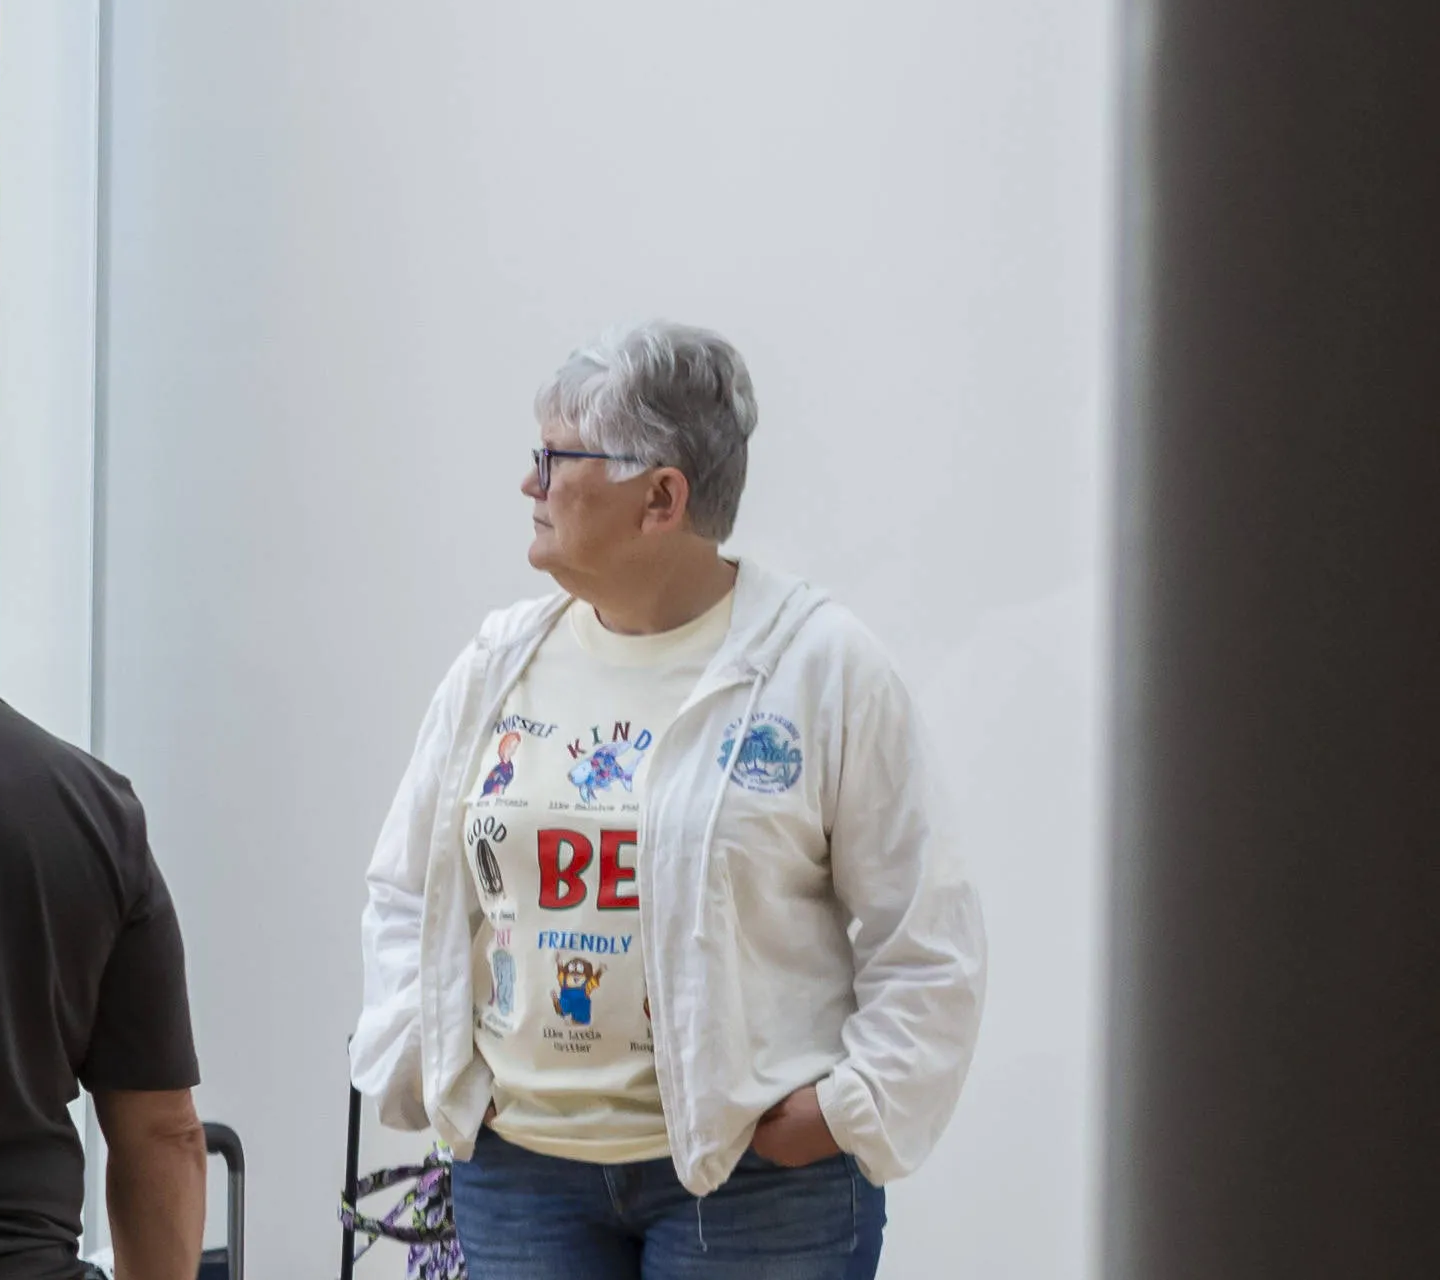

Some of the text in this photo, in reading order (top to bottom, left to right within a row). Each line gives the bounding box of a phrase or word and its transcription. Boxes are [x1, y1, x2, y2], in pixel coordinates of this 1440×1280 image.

[567, 720, 652, 759] KIND
[537, 828, 641, 911] BE
[537, 930, 633, 955] FRIENDLY
